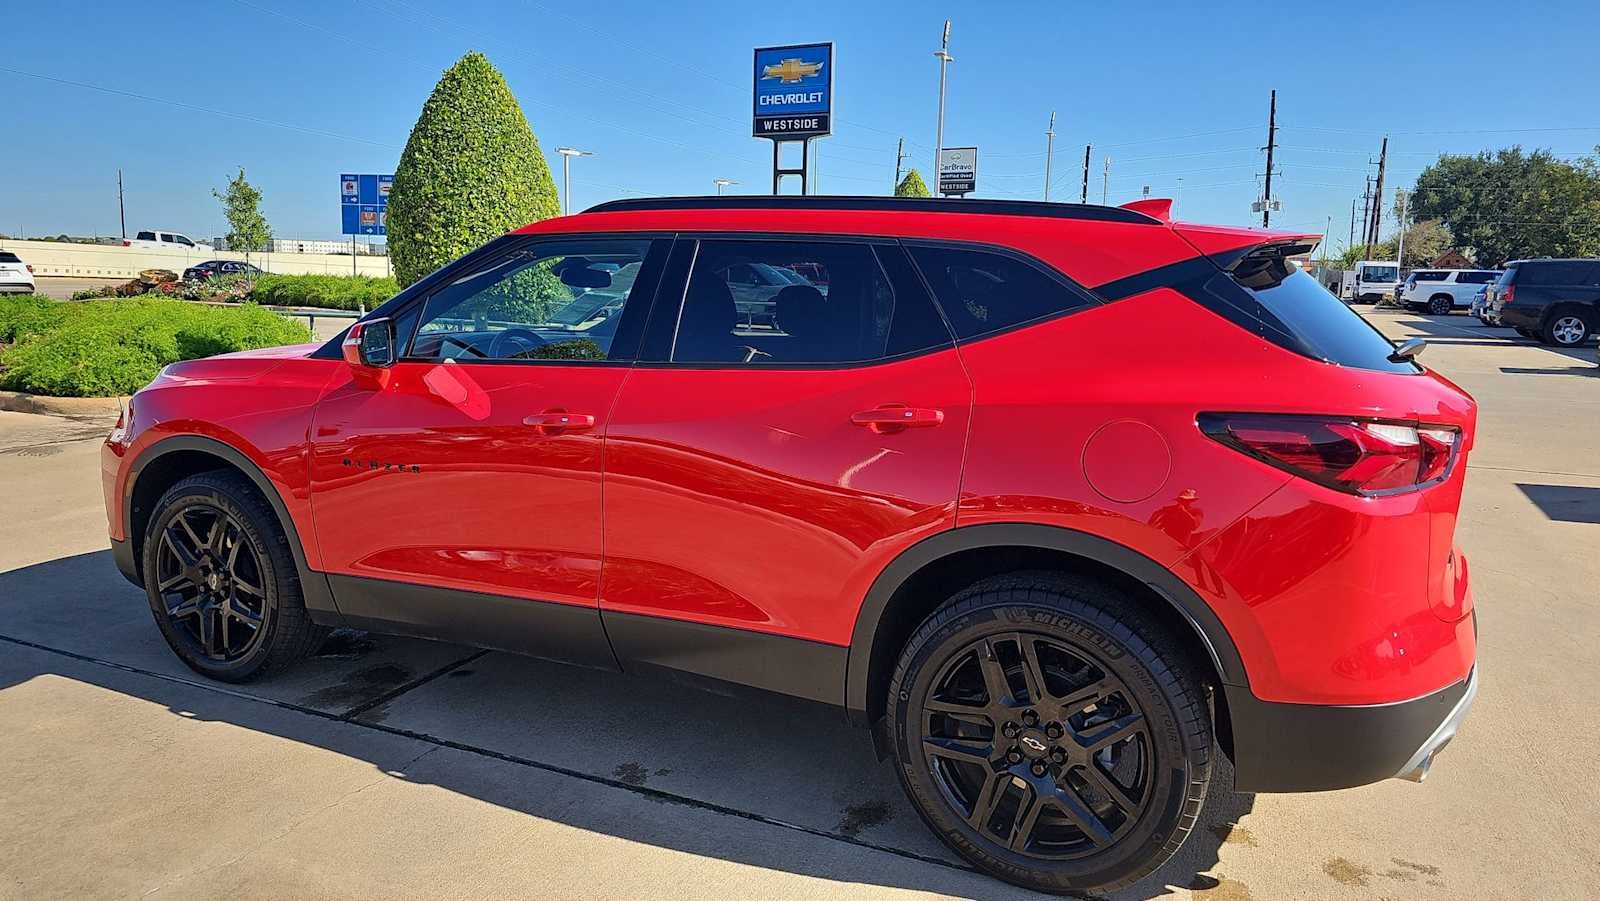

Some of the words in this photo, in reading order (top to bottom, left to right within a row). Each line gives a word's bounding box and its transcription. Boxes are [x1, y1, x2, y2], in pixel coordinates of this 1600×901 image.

[760, 92, 823, 105] CHEVROLET
[764, 118, 819, 130] WESTSIDE
[343, 459, 420, 473] BLAZER
[1034, 612, 1122, 656] MICHELIN
